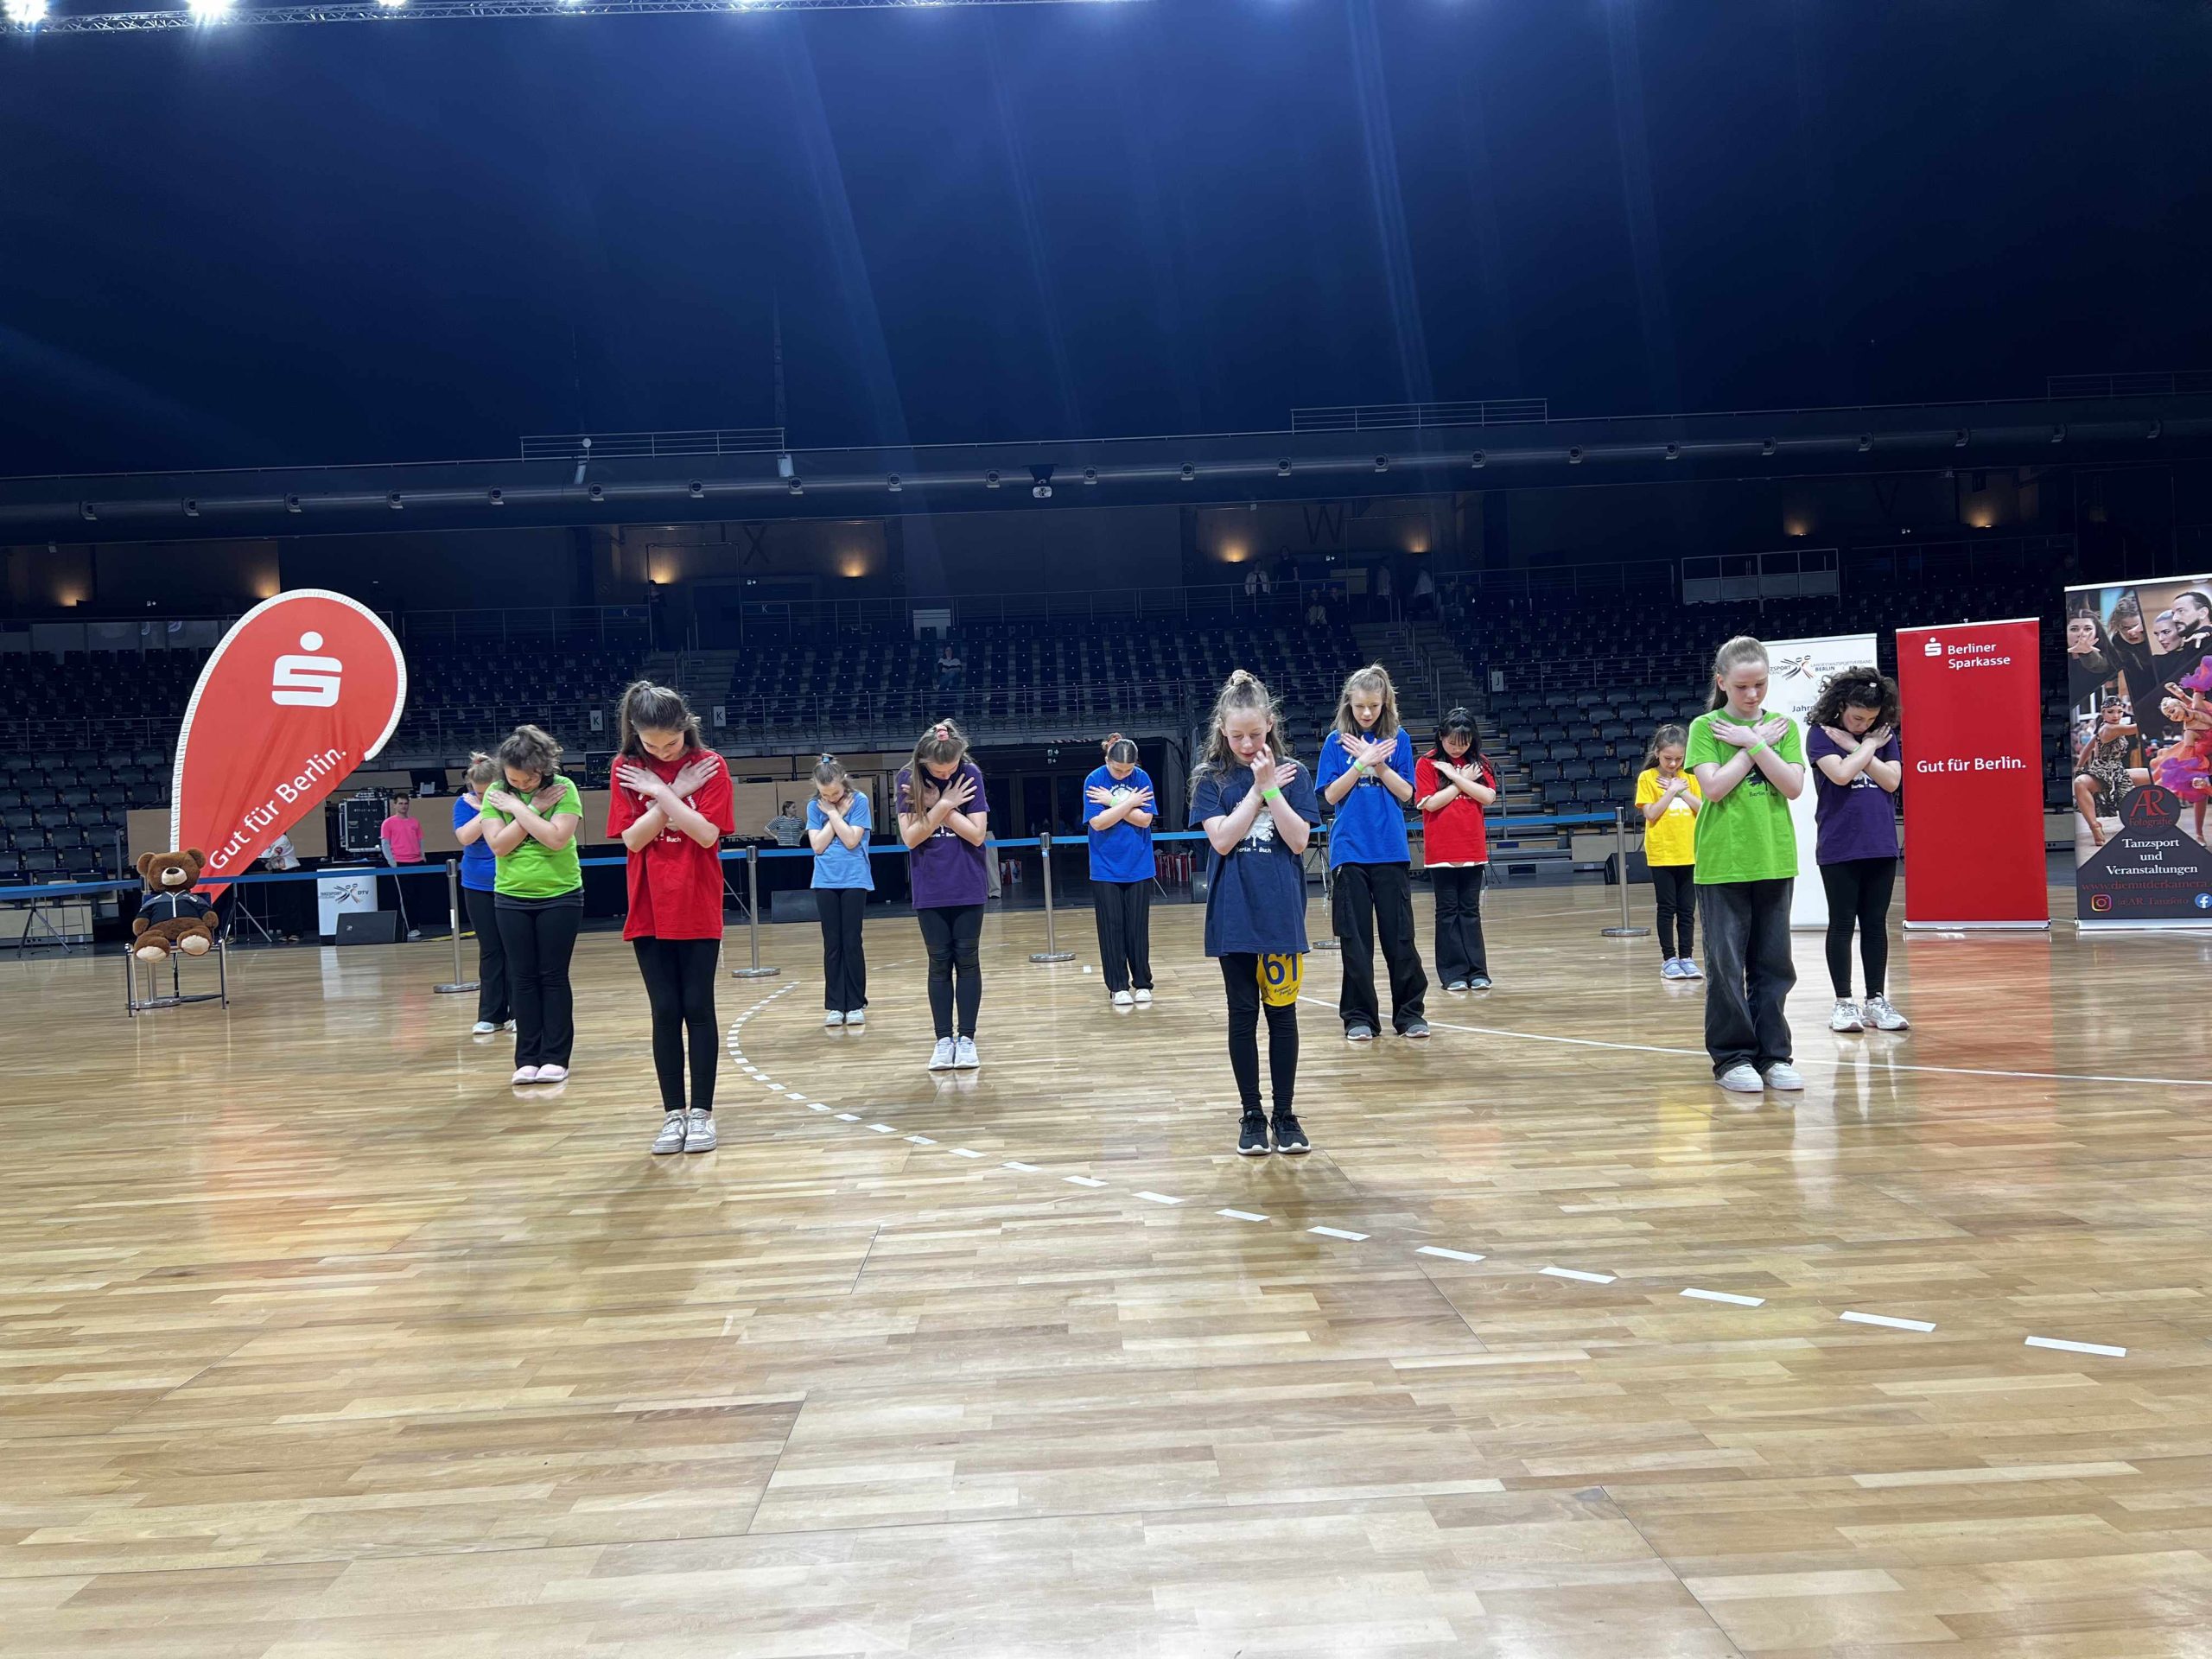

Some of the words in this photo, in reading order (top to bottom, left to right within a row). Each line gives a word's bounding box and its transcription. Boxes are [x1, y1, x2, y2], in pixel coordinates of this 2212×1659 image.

[1303, 505, 1344, 544] W
[743, 525, 771, 565] X
[622, 607, 629, 617] K
[762, 604, 768, 613] K
[1948, 643, 1997, 655] Berliner
[1948, 657, 2012, 670] Sparkasse
[593, 715, 600, 726] K
[716, 711, 723, 721] K
[1916, 760, 1944, 772] Gut
[1948, 759, 1970, 772] für
[1974, 756, 2026, 770] Berlin.
[209, 830, 251, 869] Gut
[244, 799, 279, 833] für
[275, 748, 346, 804] Berlin.
[2130, 790, 2170, 817] AR
[2122, 838, 2179, 849] Tanzsport
[2139, 851, 2163, 861] und
[2106, 865, 2197, 875] Veranstaltungen
[1262, 953, 1298, 985] 61
